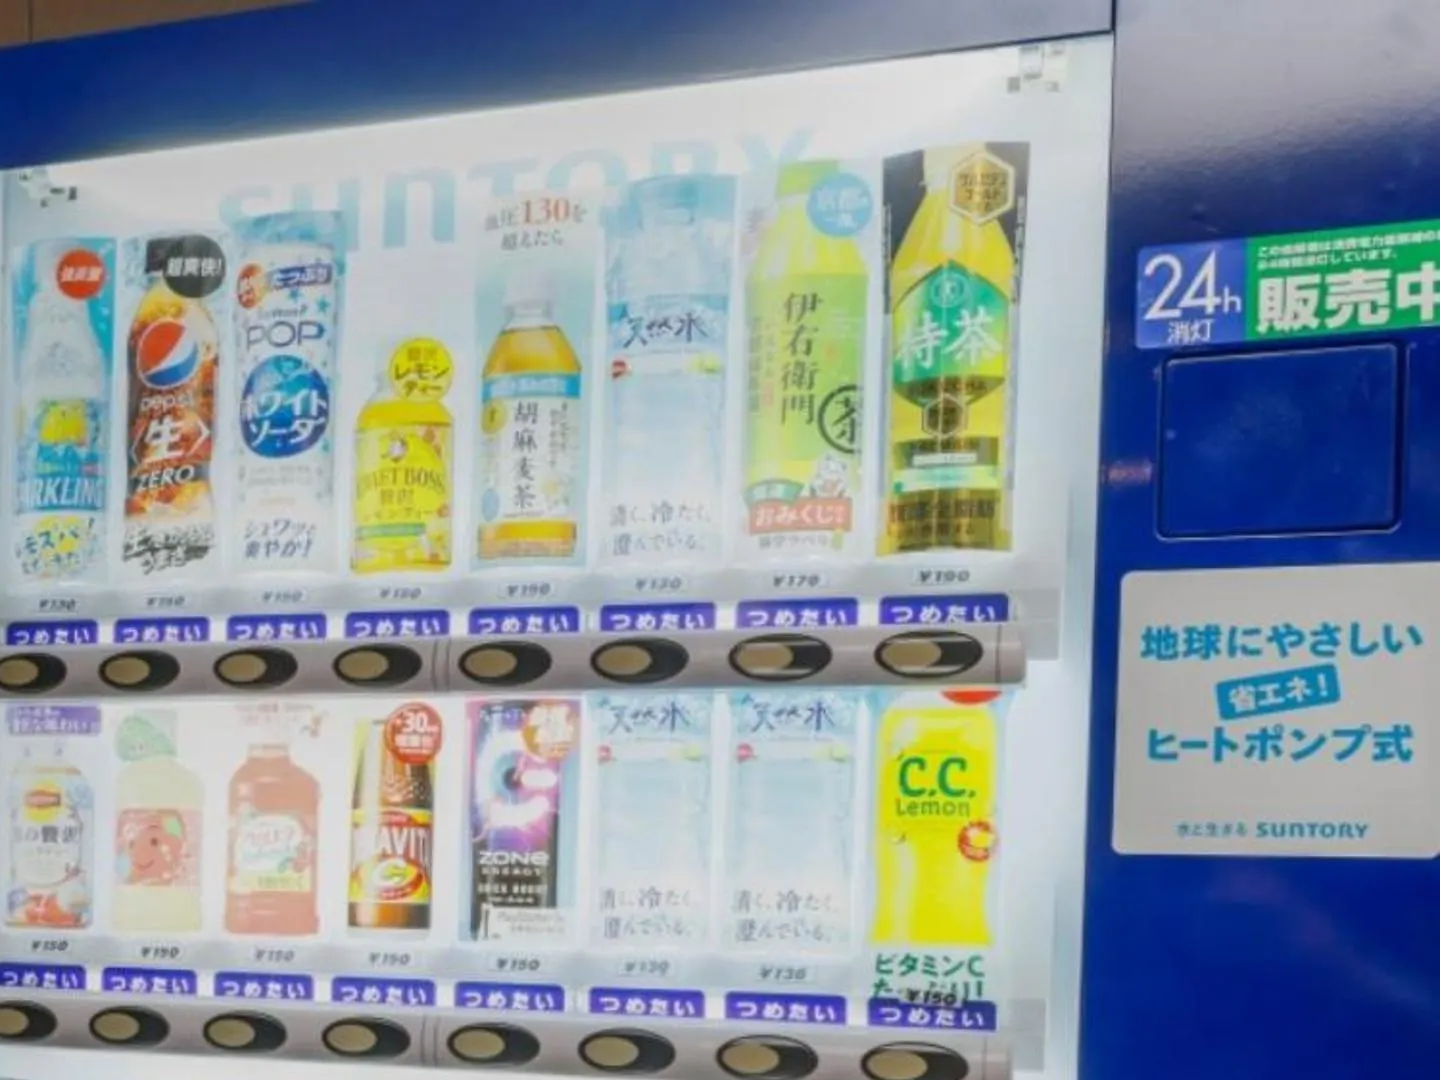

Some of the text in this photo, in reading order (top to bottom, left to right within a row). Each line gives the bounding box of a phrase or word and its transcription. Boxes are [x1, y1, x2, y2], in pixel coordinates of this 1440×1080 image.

[165, 258, 223, 278] 超爽快!
[1257, 261, 1440, 333] 販売中
[247, 321, 328, 350] POP
[623, 312, 709, 348] 天然水
[897, 306, 1003, 369] 特茶
[1167, 319, 1213, 344] 消灯
[781, 292, 823, 425] 伊右衛門
[394, 362, 450, 381] レモン
[404, 381, 445, 397] ティー
[241, 388, 328, 416] ホワイト
[146, 418, 187, 461] 生
[249, 416, 327, 449] ソーダ
[513, 401, 540, 510] 胡麻麦茶
[137, 465, 196, 491] ZERO
[772, 574, 821, 588] ¥170
[610, 613, 706, 631] つめたい
[746, 608, 848, 627] つめたい
[890, 604, 997, 623] つめたい
[122, 626, 202, 643] つめたい
[235, 622, 319, 640] つめたい
[354, 618, 441, 637] つめたい
[477, 615, 570, 635] つめたい
[14, 628, 90, 645] つめたい
[1140, 621, 1424, 661] 地球にやさしい
[1229, 673, 1329, 713] 省エネ!
[610, 702, 692, 733] 天然水
[752, 700, 836, 733] 天然水
[1148, 723, 1415, 763] ヒートポンプ式
[898, 755, 977, 799] C.C.
[895, 797, 971, 818] Lemon
[1256, 822, 1369, 839] SUNTORY
[874, 953, 985, 978] ビタミンC
[2, 970, 79, 987] つめたい
[109, 976, 191, 995] つめたい
[221, 980, 307, 999] つめたい
[340, 985, 428, 1005] つめたい
[906, 988, 959, 1006] ¥150
[464, 990, 556, 1011] つめたい
[598, 996, 697, 1016] つめたい
[735, 1001, 836, 1022] つめたい
[878, 1006, 985, 1027] つめたい
